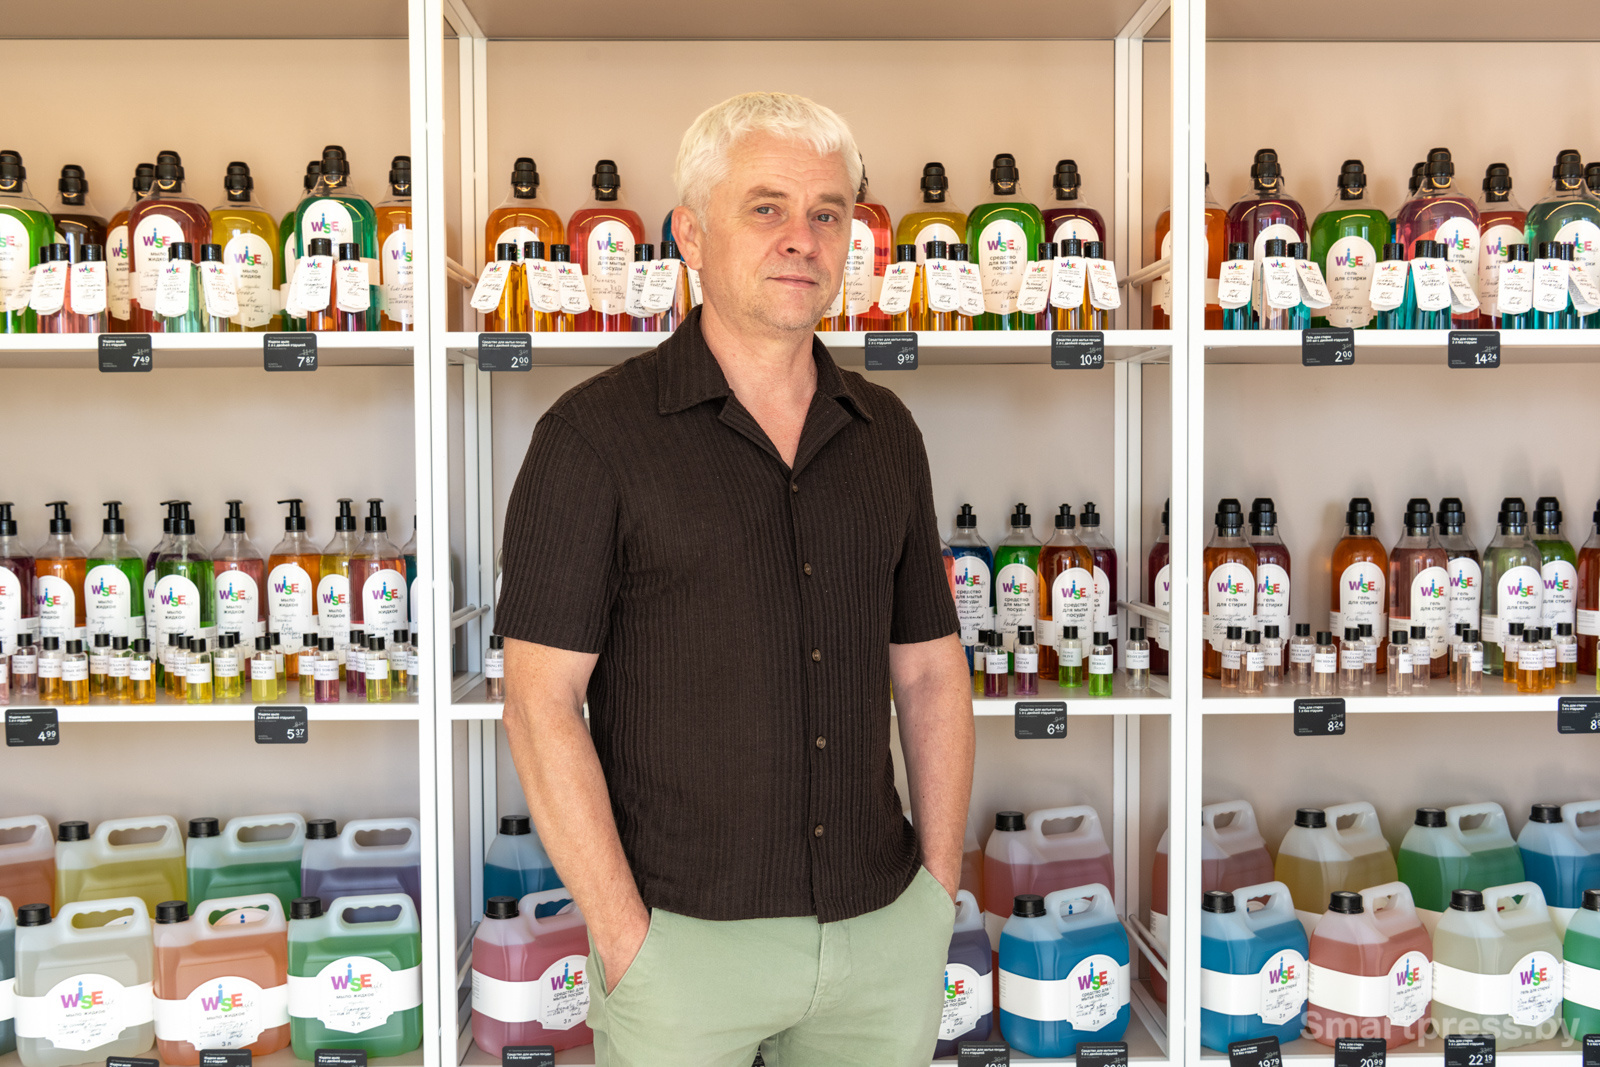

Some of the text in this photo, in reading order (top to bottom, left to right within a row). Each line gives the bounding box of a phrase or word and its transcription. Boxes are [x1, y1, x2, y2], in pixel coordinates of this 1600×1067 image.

[112, 239, 128, 258] WiS
[392, 242, 412, 262] WiS
[1486, 237, 1508, 256] WiS
